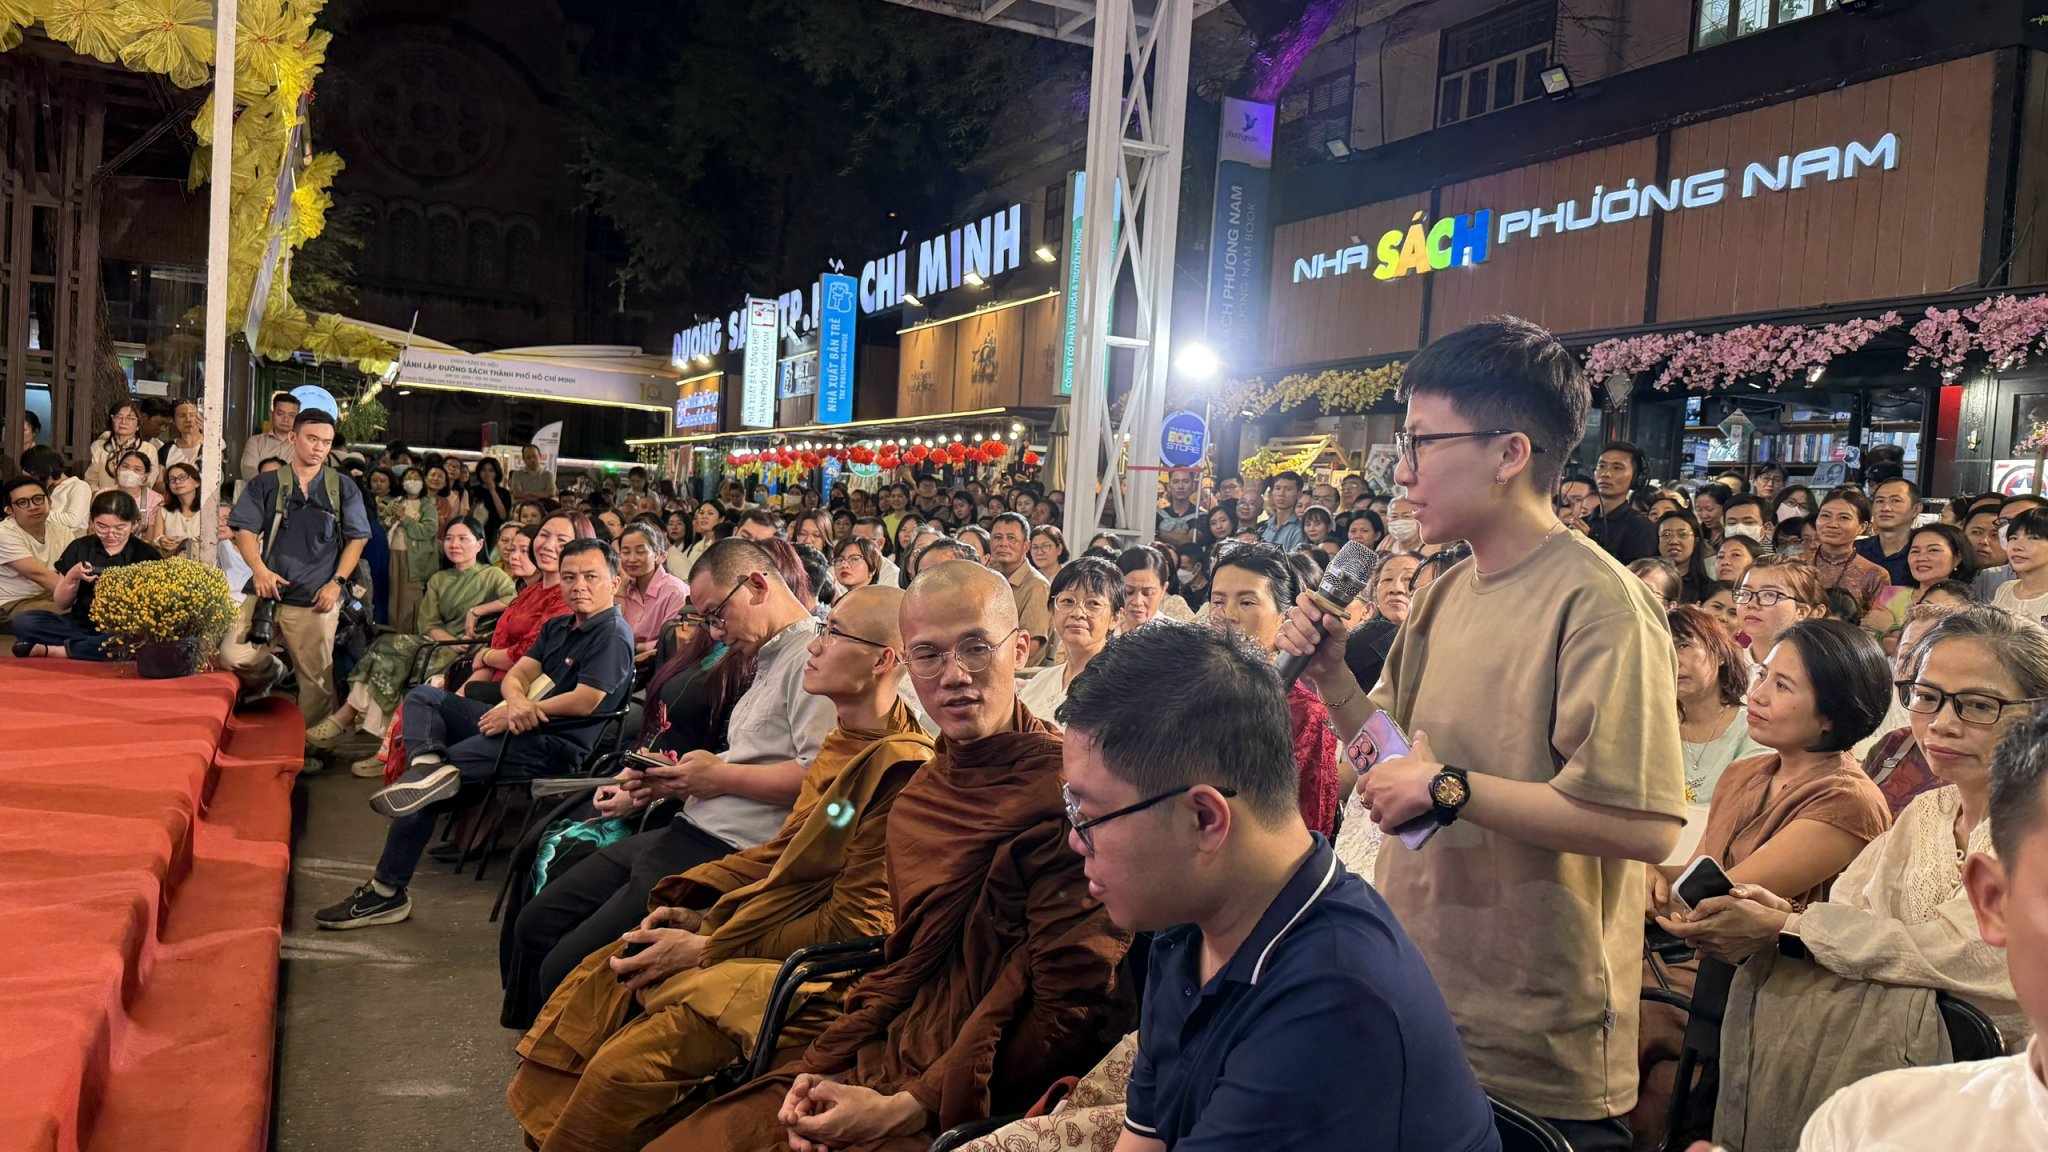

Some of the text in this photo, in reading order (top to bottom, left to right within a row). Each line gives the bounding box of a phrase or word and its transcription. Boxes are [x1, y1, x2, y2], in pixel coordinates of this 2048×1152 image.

[1230, 185, 1243, 225] NAM
[1293, 235, 1369, 283] NHÀ
[1373, 210, 1490, 281] SÁCH
[1742, 132, 1900, 198] NAM
[1245, 203, 1256, 241] BOOK
[1242, 246, 1253, 278] NAM
[728, 292, 748, 351] SÁ
[860, 230, 908, 314] CHÍ
[917, 203, 1021, 298] MINH
[827, 317, 841, 337] TRẺ
[826, 339, 840, 360] BẢN
[840, 333, 849, 352] HOUSE
[439, 363, 467, 374] ĐƯỜNG
[468, 366, 488, 375] SÁCH
[489, 369, 514, 378] THÀNH
[515, 371, 531, 379] PHỐ
[825, 361, 839, 388] XUẤT
[839, 353, 848, 388] PUBLISHING
[825, 390, 838, 412] NHÀ
[1166, 443, 1201, 455] STORE
[1168, 430, 1202, 447] BOOK
